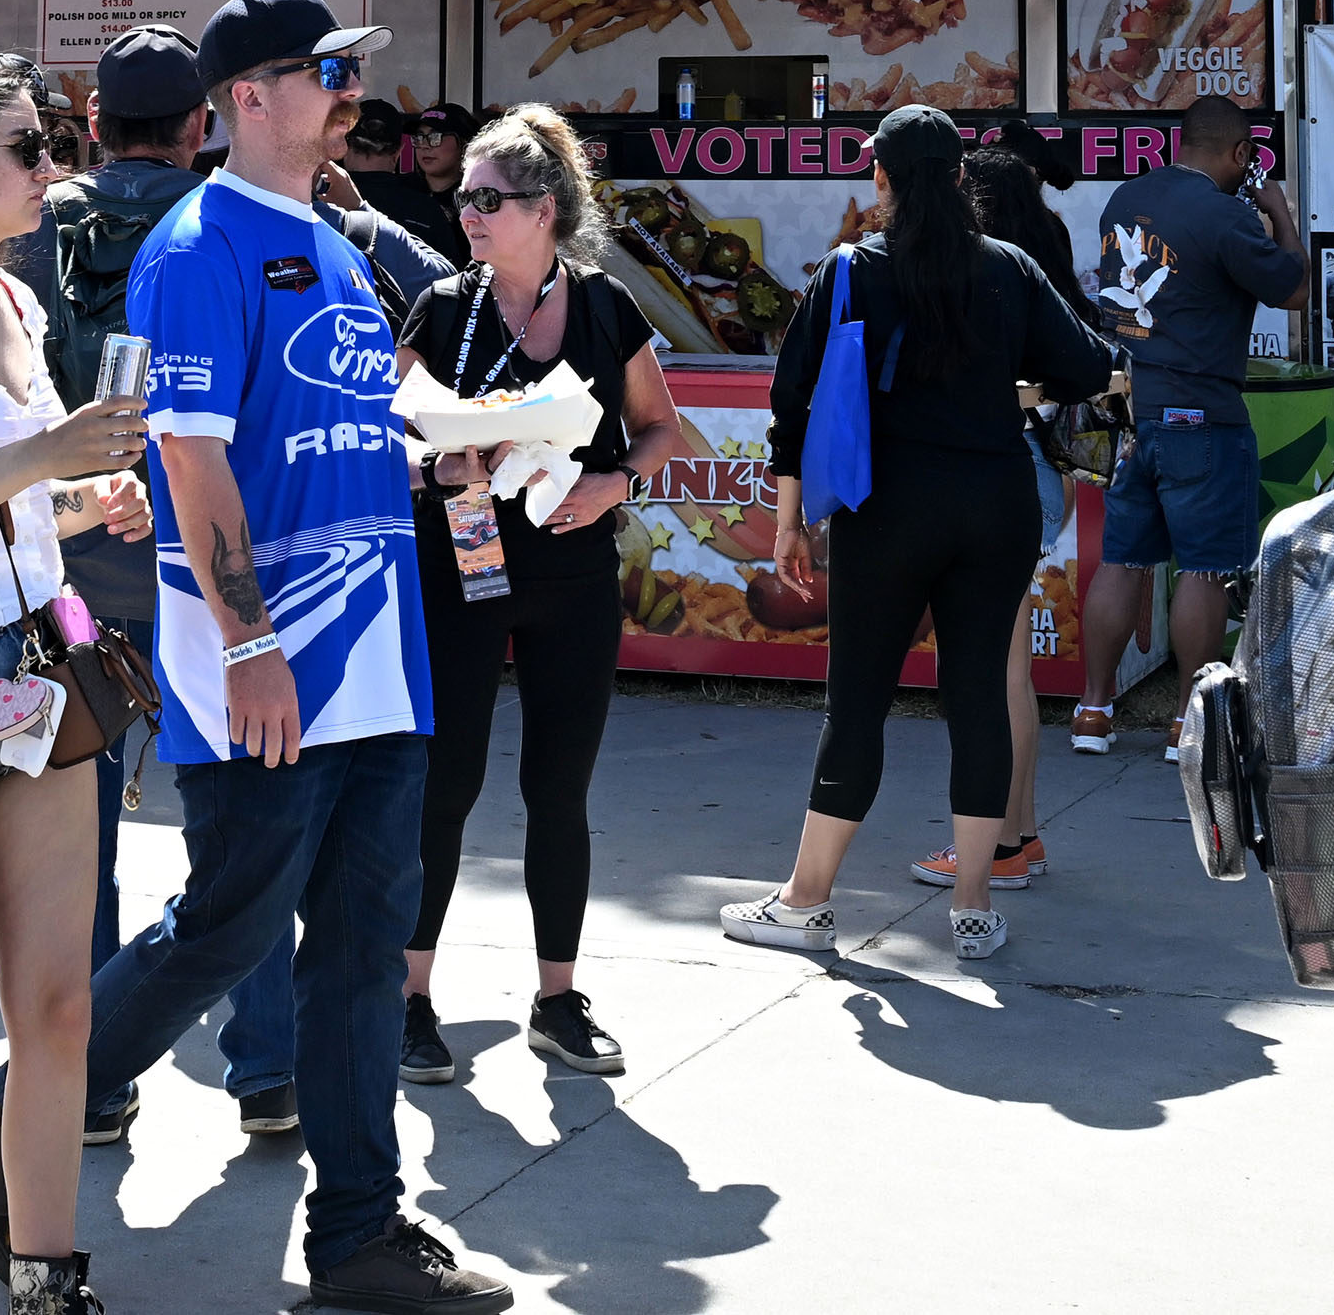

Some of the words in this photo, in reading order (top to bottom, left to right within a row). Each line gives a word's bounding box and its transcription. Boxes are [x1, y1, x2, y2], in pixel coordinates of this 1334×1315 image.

[48, 12, 85, 21] POLISH
[88, 12, 109, 20] DOG
[111, 11, 136, 20] MILD
[139, 11, 153, 19] OR
[156, 10, 187, 19] SPICY
[101, 0, 133, 7] $13.00
[101, 24, 133, 33] $14.00
[60, 38, 92, 46] ELLEN
[94, 38, 101, 46] D
[1158, 47, 1243, 71] VEGGIE
[1196, 72, 1252, 96] DOG
[650, 127, 872, 174] VOTED
[1082, 126, 1276, 175] FRIS
[634, 223, 653, 243] NOT
[649, 240, 687, 281] AVAILABLE
[1101, 227, 1179, 274] PACE
[455, 341, 471, 374] GRAND
[463, 317, 477, 340] PRIX
[471, 287, 487, 310] LONG
[641, 458, 778, 510] INK'S
[228, 646, 253, 660] Modelo
